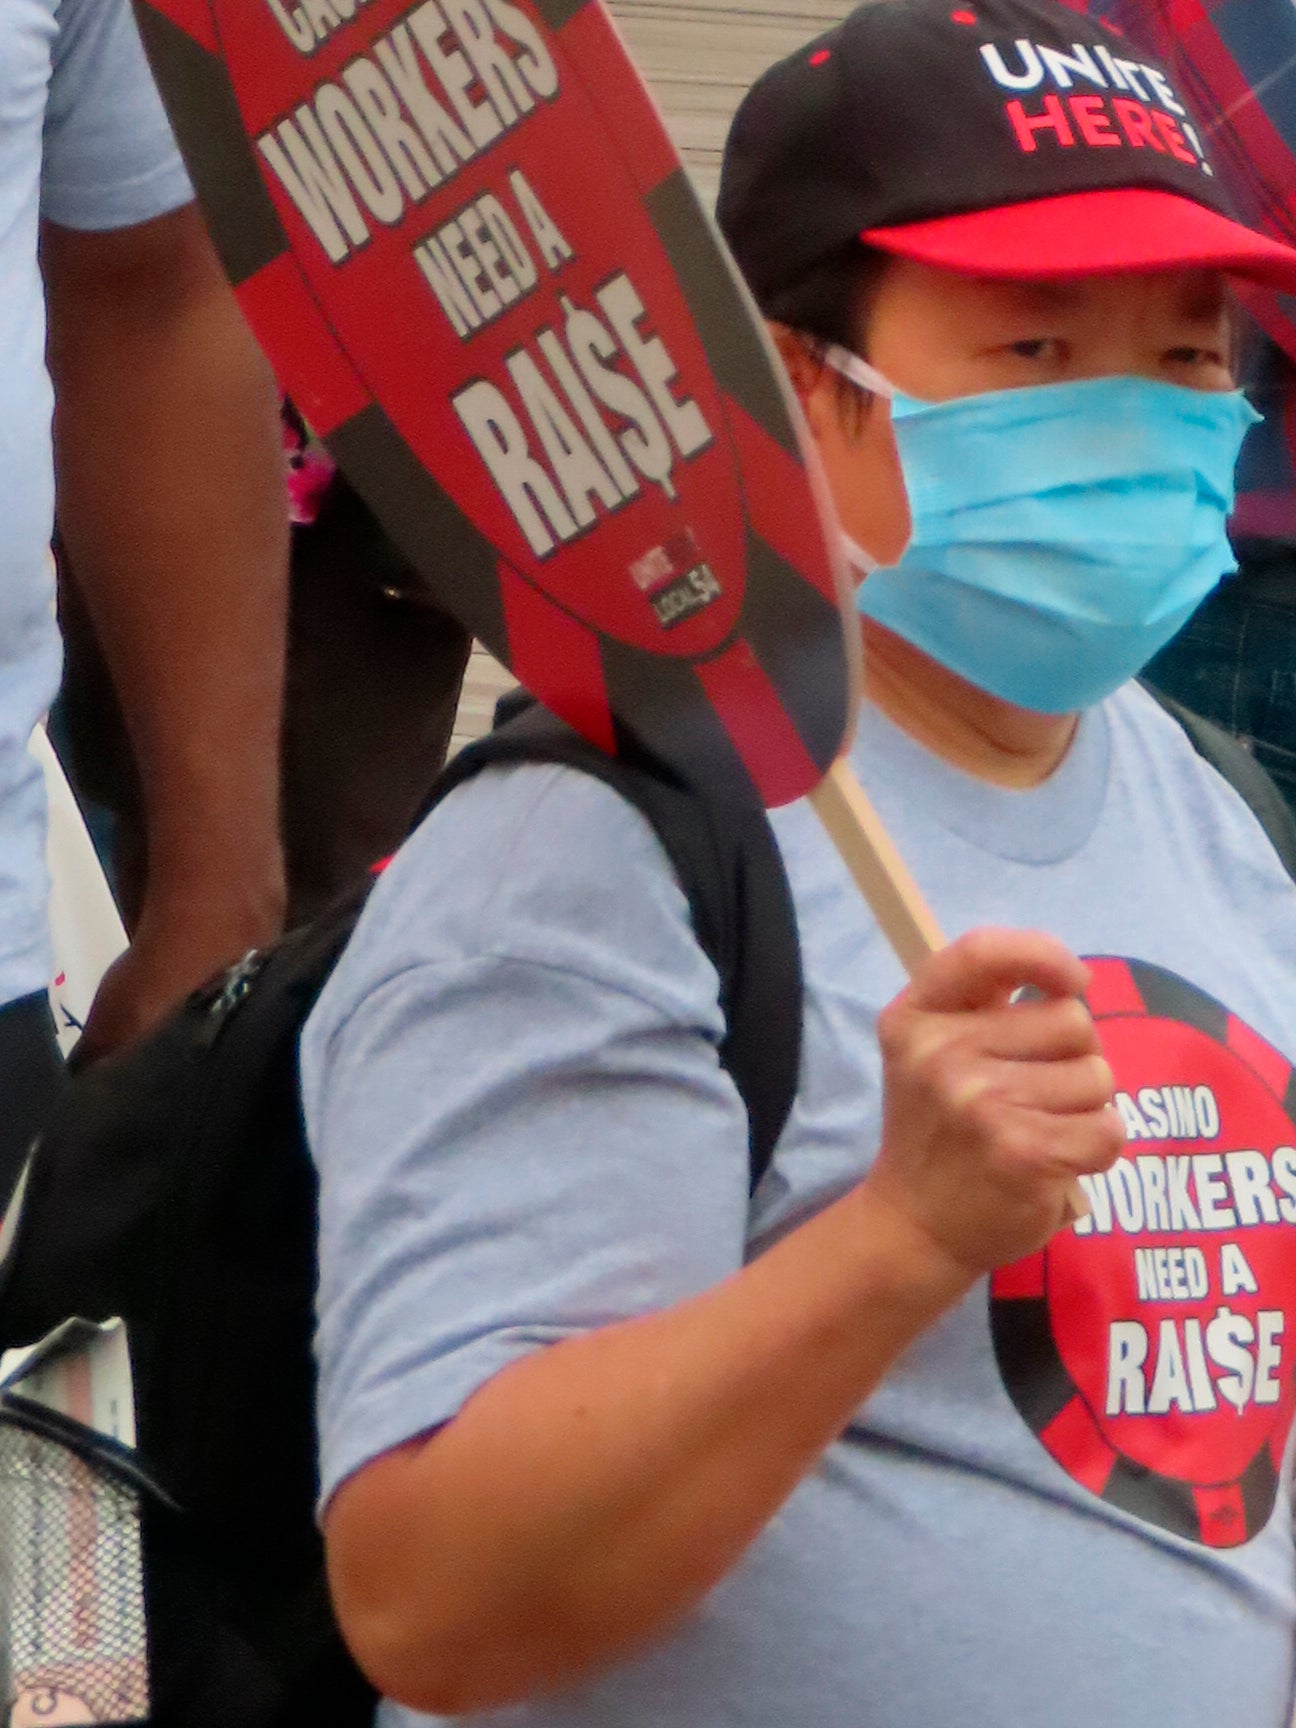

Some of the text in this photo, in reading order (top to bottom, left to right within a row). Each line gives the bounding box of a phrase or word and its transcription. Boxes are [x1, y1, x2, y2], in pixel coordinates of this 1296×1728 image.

[979, 38, 1186, 117] UNITE
[1006, 94, 1214, 176] HERE!
[412, 169, 574, 339] NEED A
[451, 272, 713, 558] RAI$E
[1109, 1084, 1219, 1141] ASINO
[1134, 1242, 1259, 1301] NEED A
[1105, 1306, 1285, 1416] RAI$E
